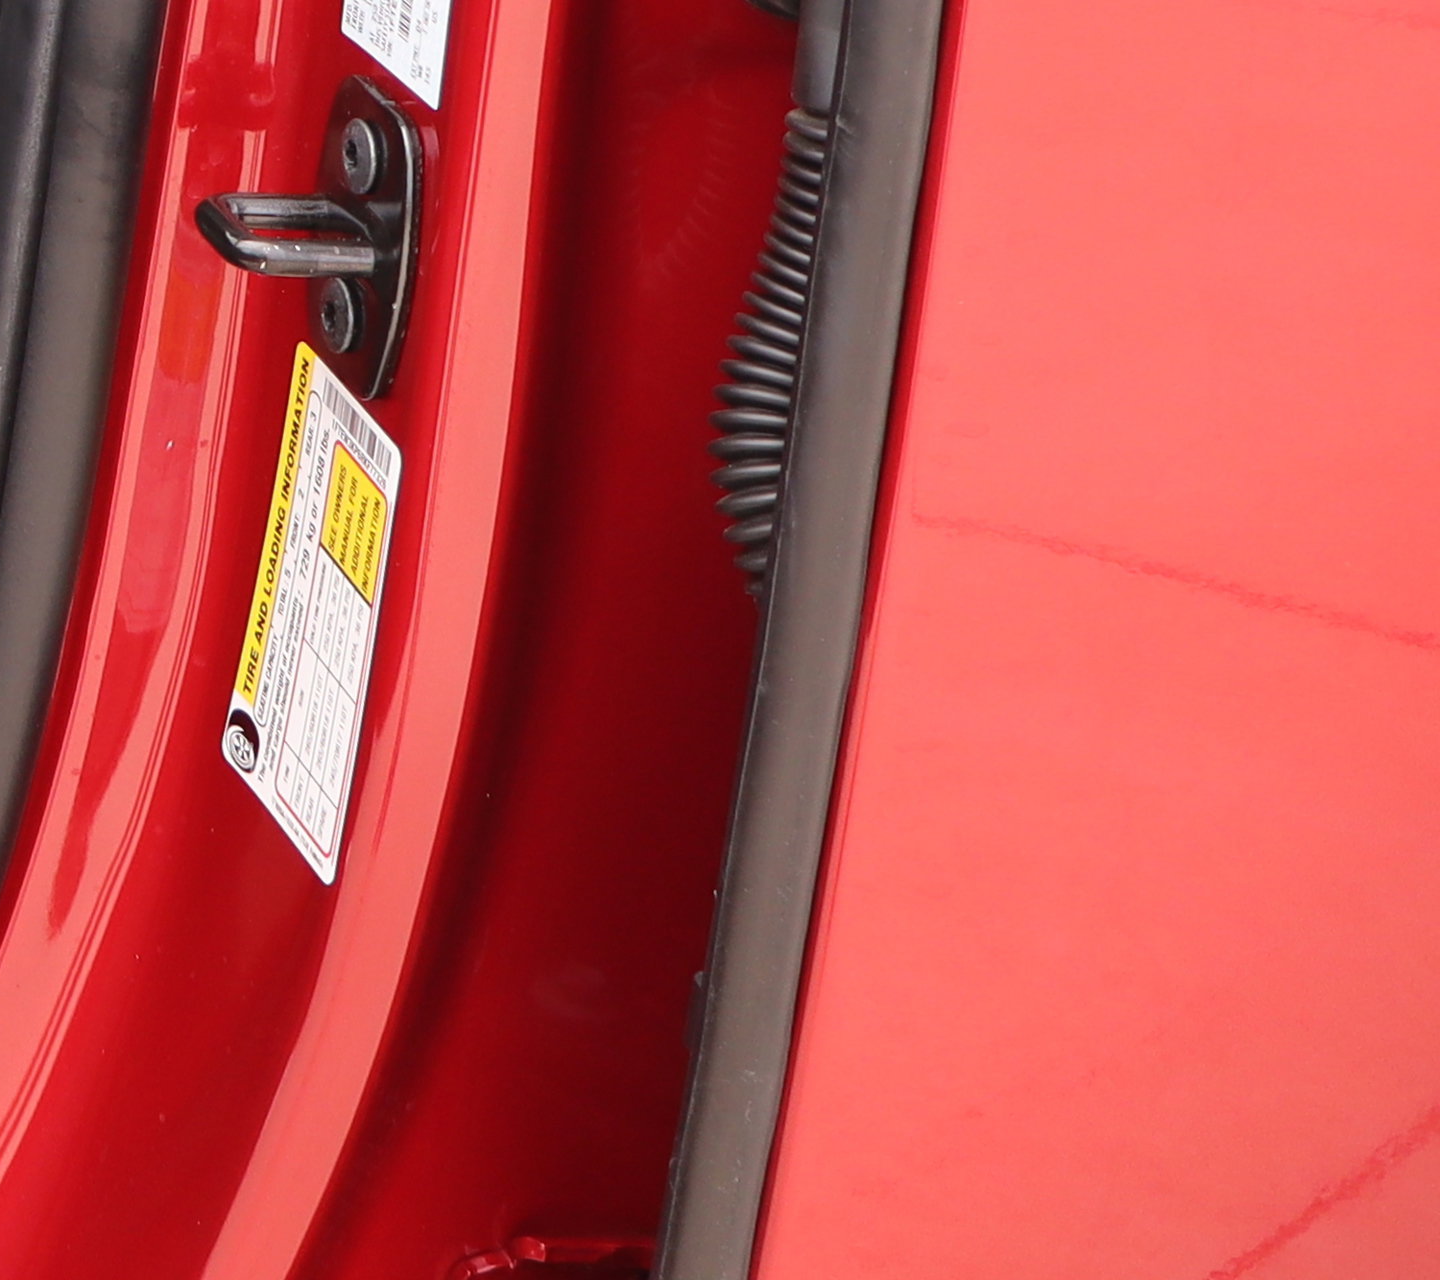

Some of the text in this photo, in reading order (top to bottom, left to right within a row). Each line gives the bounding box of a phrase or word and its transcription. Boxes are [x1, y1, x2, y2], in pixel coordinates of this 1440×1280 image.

[242, 355, 311, 700] TIRE AND LOADING INFORMATION
[298, 423, 330, 582] 729 kg or 1608 lbs.
[327, 463, 347, 553] SEE OWNERS
[338, 474, 358, 566] MANUAL FOR
[349, 491, 368, 577] ADDITIONAL
[359, 495, 382, 595] INFORMATION
[257, 677, 269, 722] SEATING
[264, 629, 278, 682] CAPACITY
[304, 423, 314, 457] REAR:
[257, 760, 266, 784] The
[262, 704, 277, 763] combined
[272, 665, 285, 708] weight
[284, 594, 298, 655] occupants
[267, 601, 304, 772] and cargo should never exceed
[294, 773, 304, 811] FRONT
[305, 795, 314, 825] REAR
